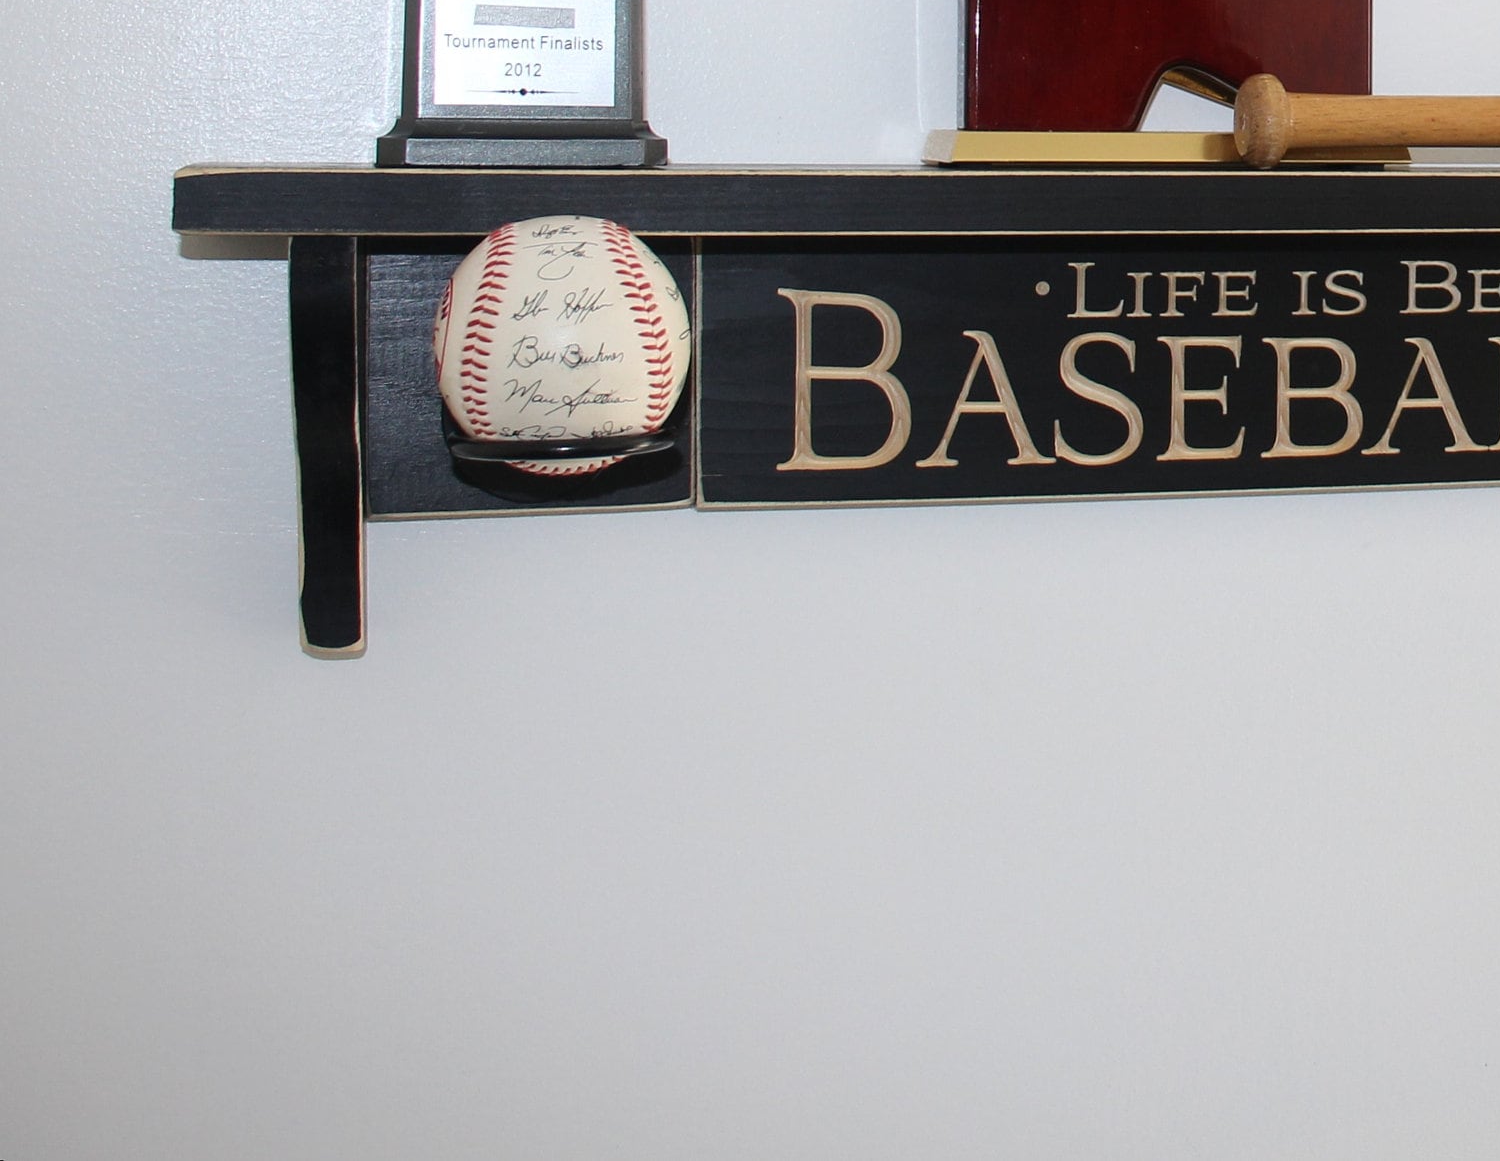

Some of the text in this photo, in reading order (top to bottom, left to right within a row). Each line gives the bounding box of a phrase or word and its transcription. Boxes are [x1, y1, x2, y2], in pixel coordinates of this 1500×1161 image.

[444, 34, 604, 51] Tournament Finalists
[504, 63, 542, 77] 2012
[1291, 269, 1368, 316] IS
